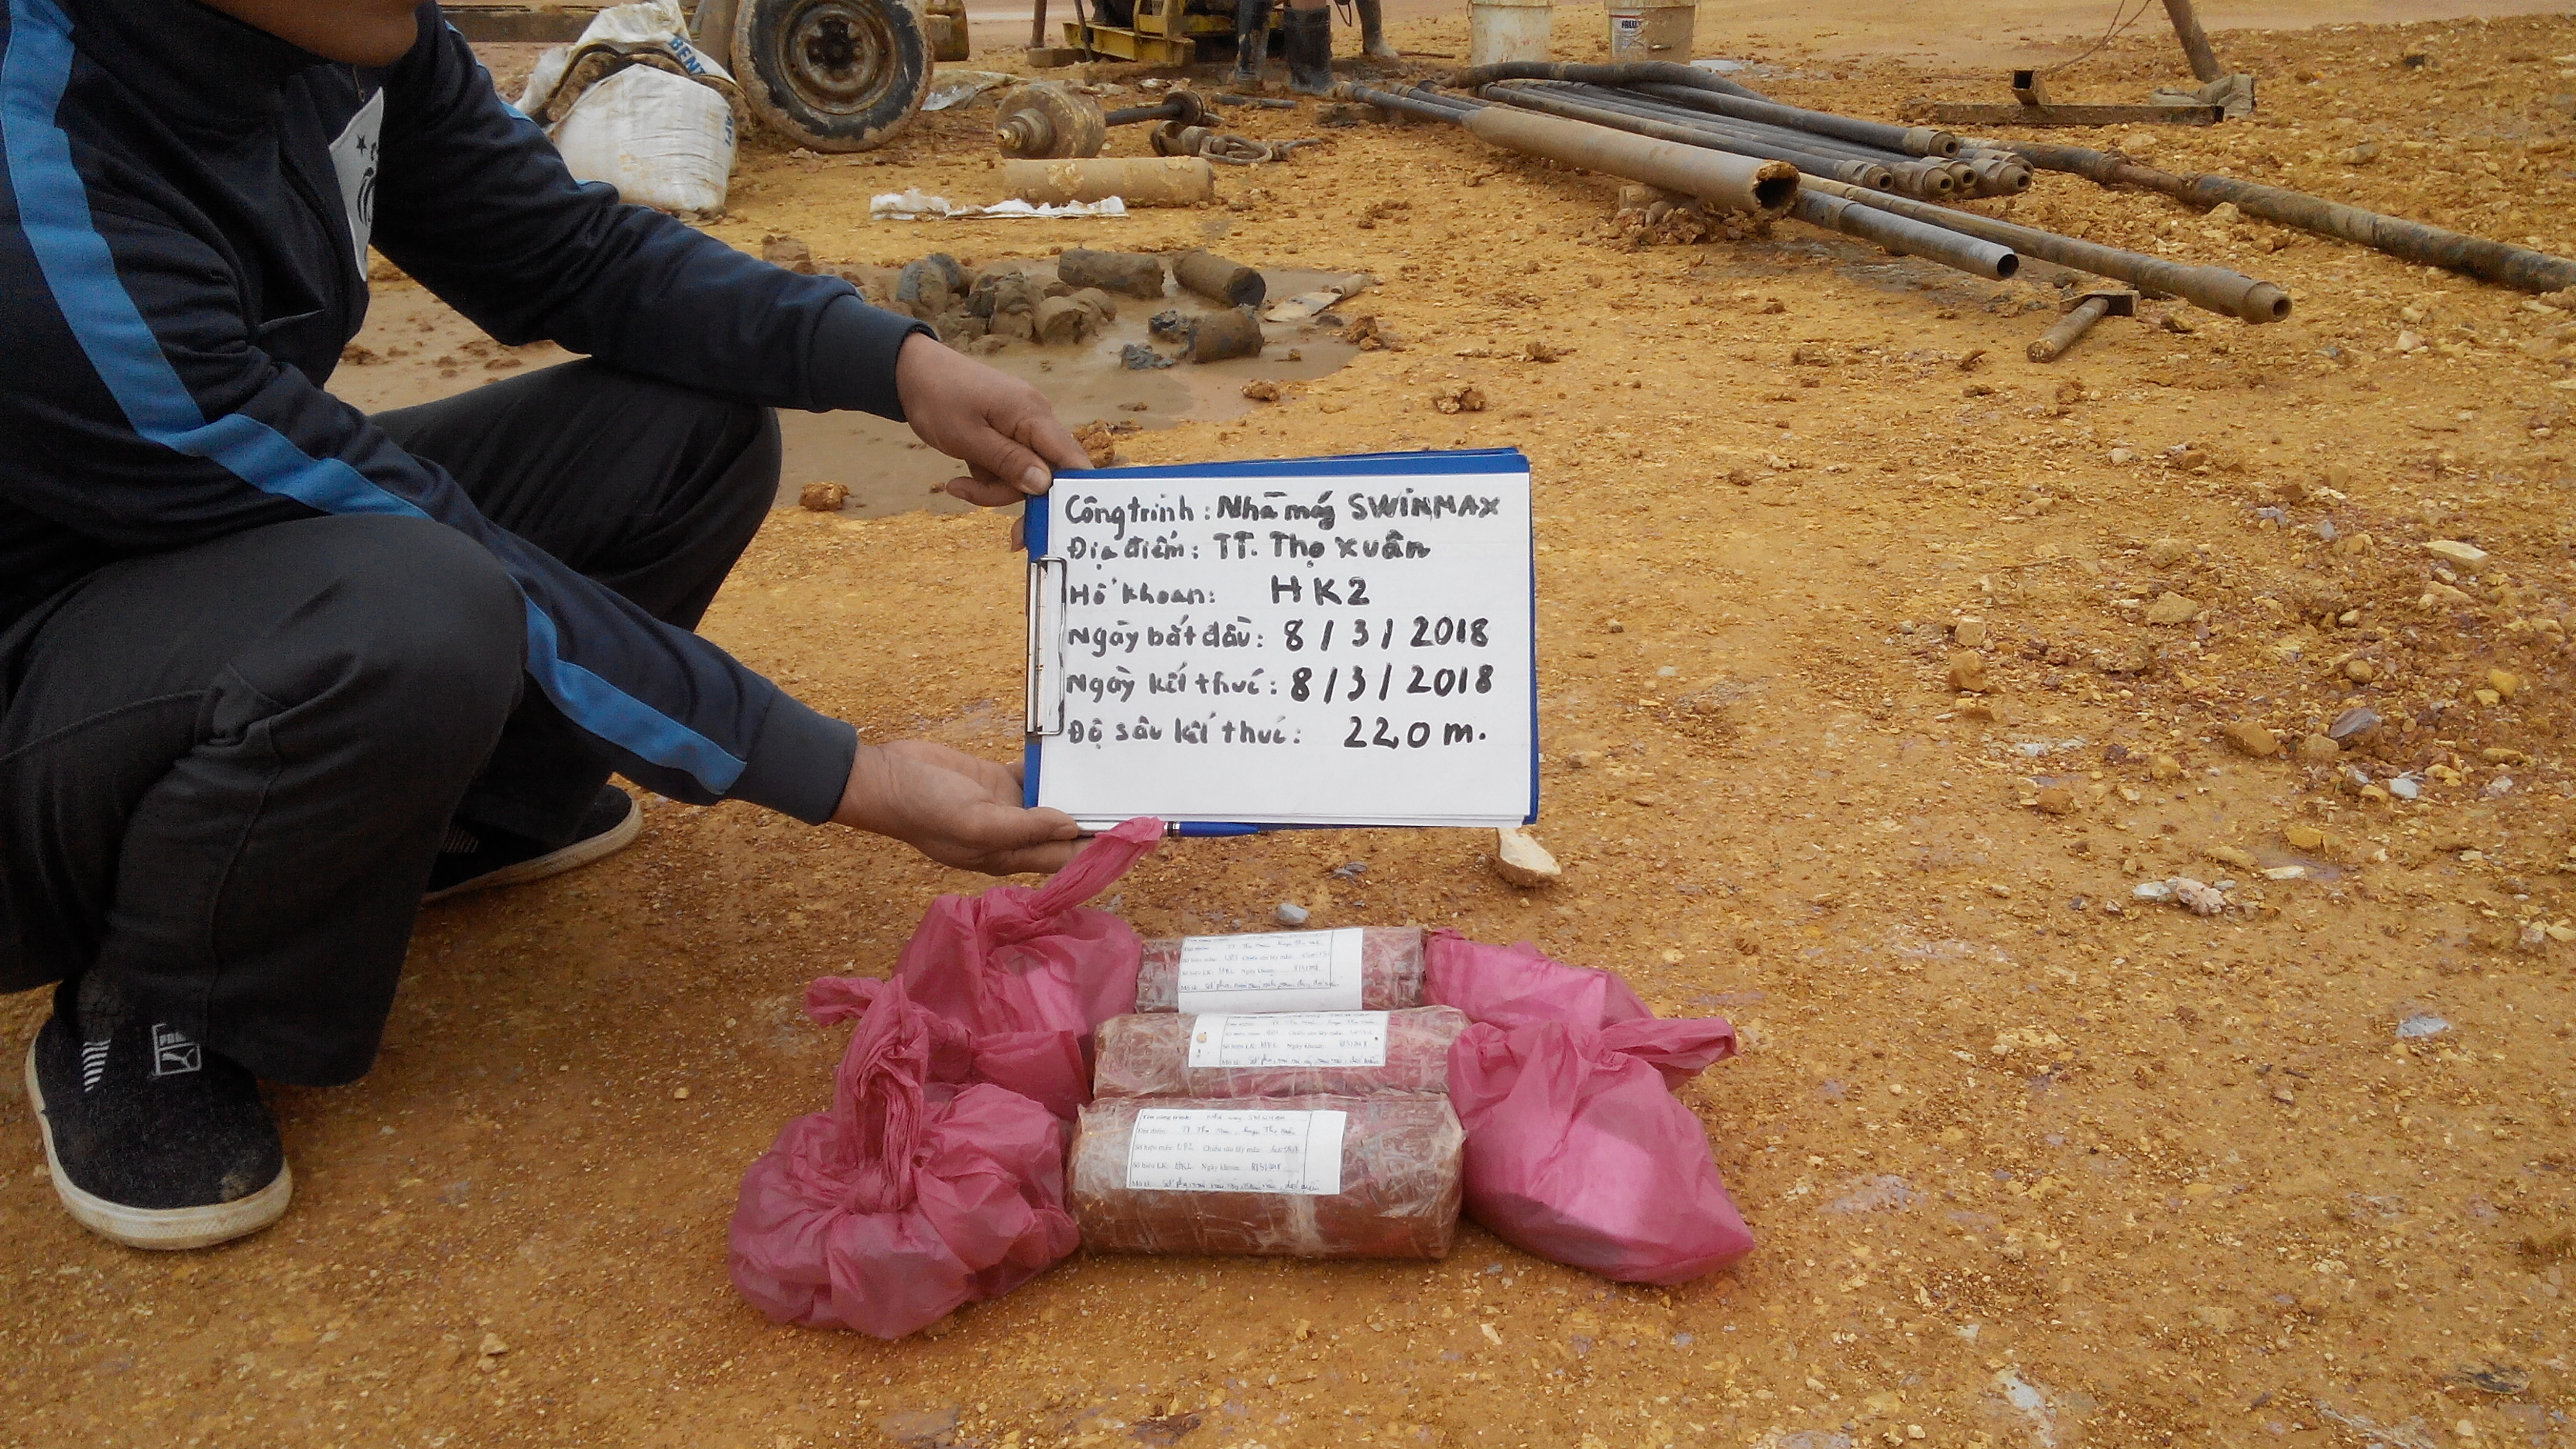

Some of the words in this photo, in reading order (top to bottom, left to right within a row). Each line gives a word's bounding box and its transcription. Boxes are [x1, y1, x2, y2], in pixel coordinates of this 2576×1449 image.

[1065, 495, 1125, 540] Công
[1213, 531, 1257, 560] TT.
[1269, 531, 1324, 568] Thọ
[1067, 620, 1139, 657] Ngày
[1067, 666, 1135, 703] Ngày
[1067, 718, 1102, 749] Độ
[1115, 715, 1162, 741] sâu
